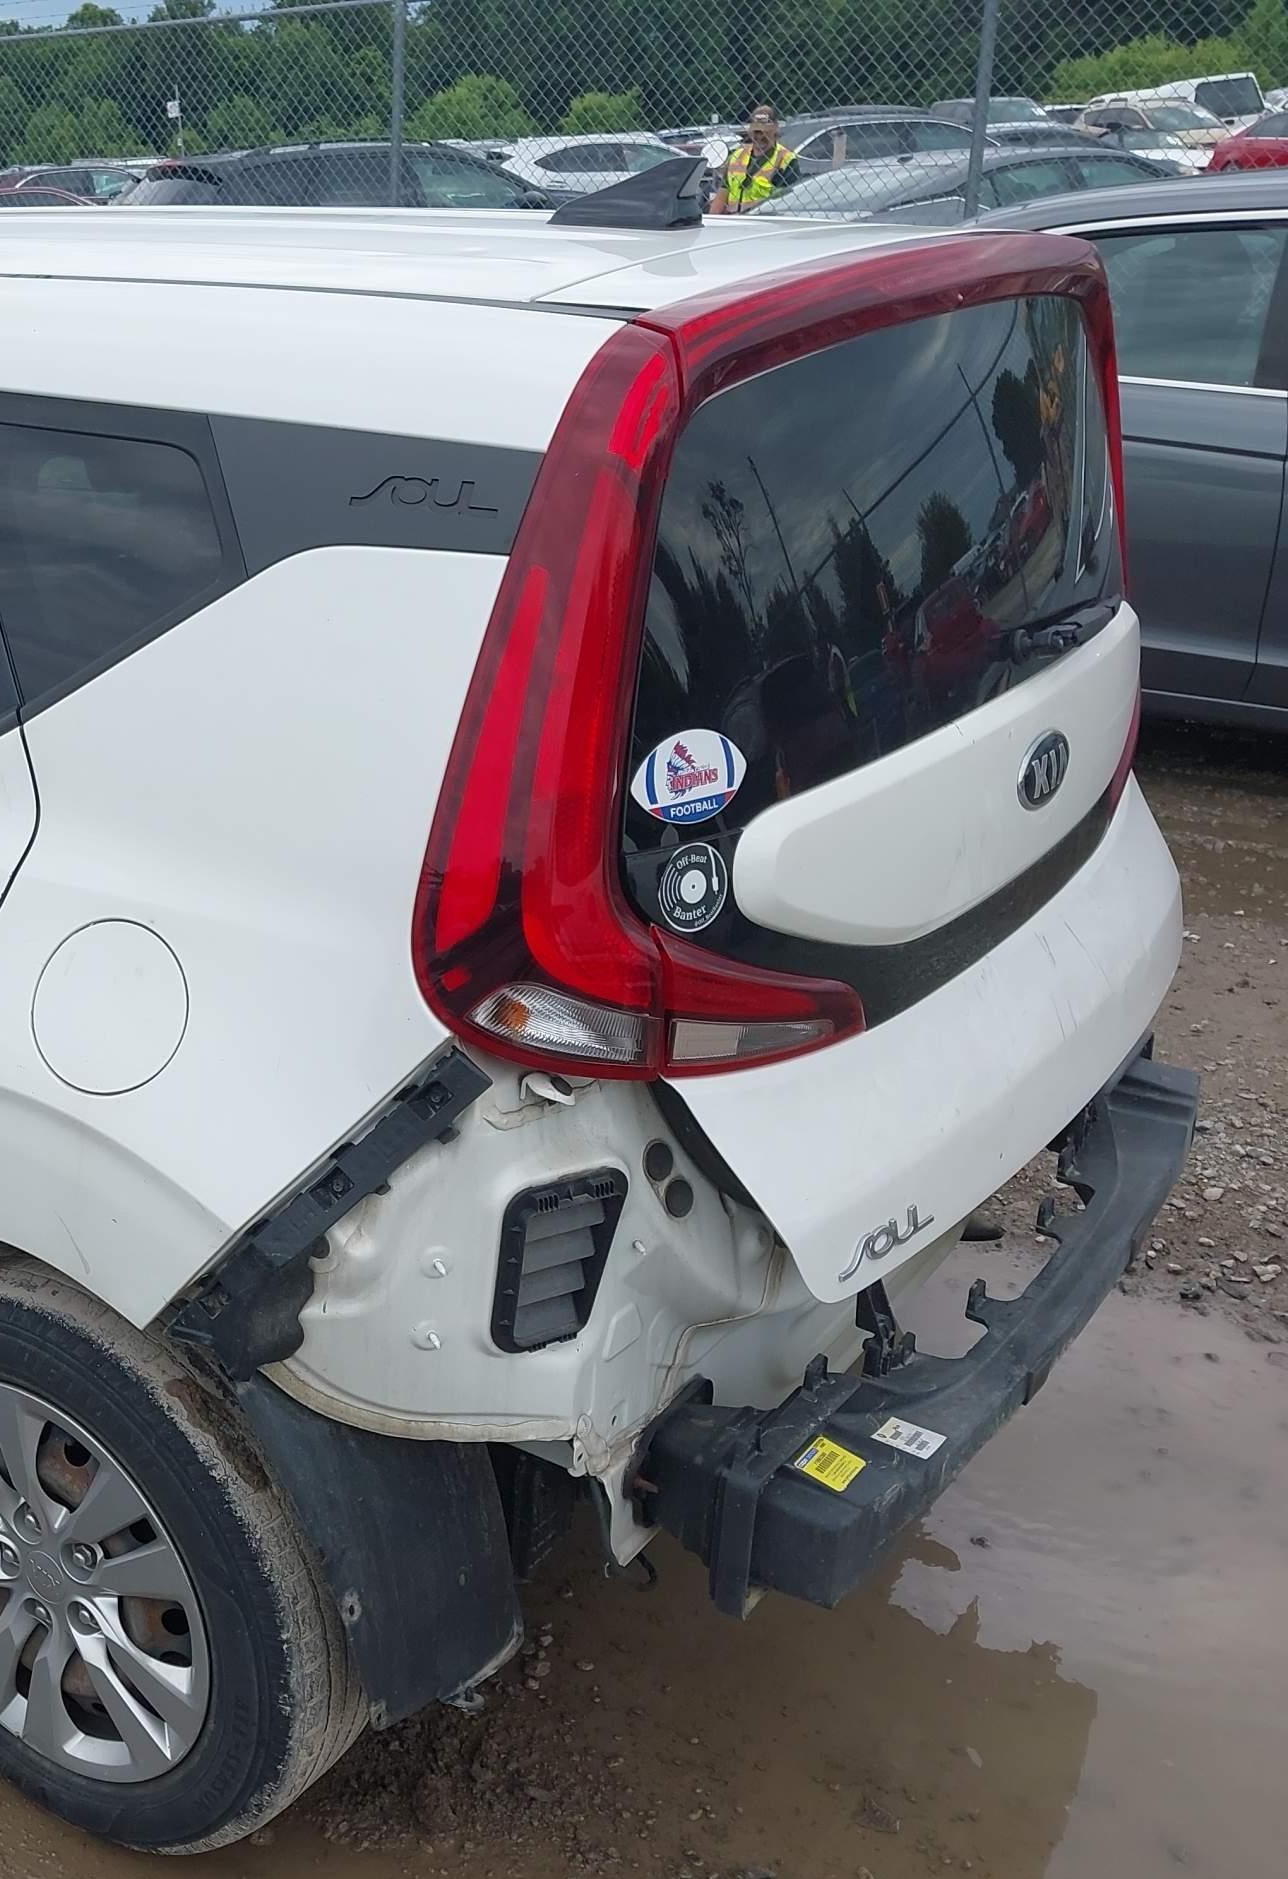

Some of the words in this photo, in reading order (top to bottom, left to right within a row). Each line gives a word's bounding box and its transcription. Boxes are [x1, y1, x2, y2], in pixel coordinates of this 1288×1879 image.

[349, 475, 499, 519] SOUL
[670, 767, 719, 792] INDIANS
[1031, 742, 1068, 800] KIA
[670, 798, 719, 818] FOOTBALL
[675, 853, 708, 870] Off-Beat
[672, 904, 708, 921] Banter
[838, 1204, 935, 1283] SOUL
